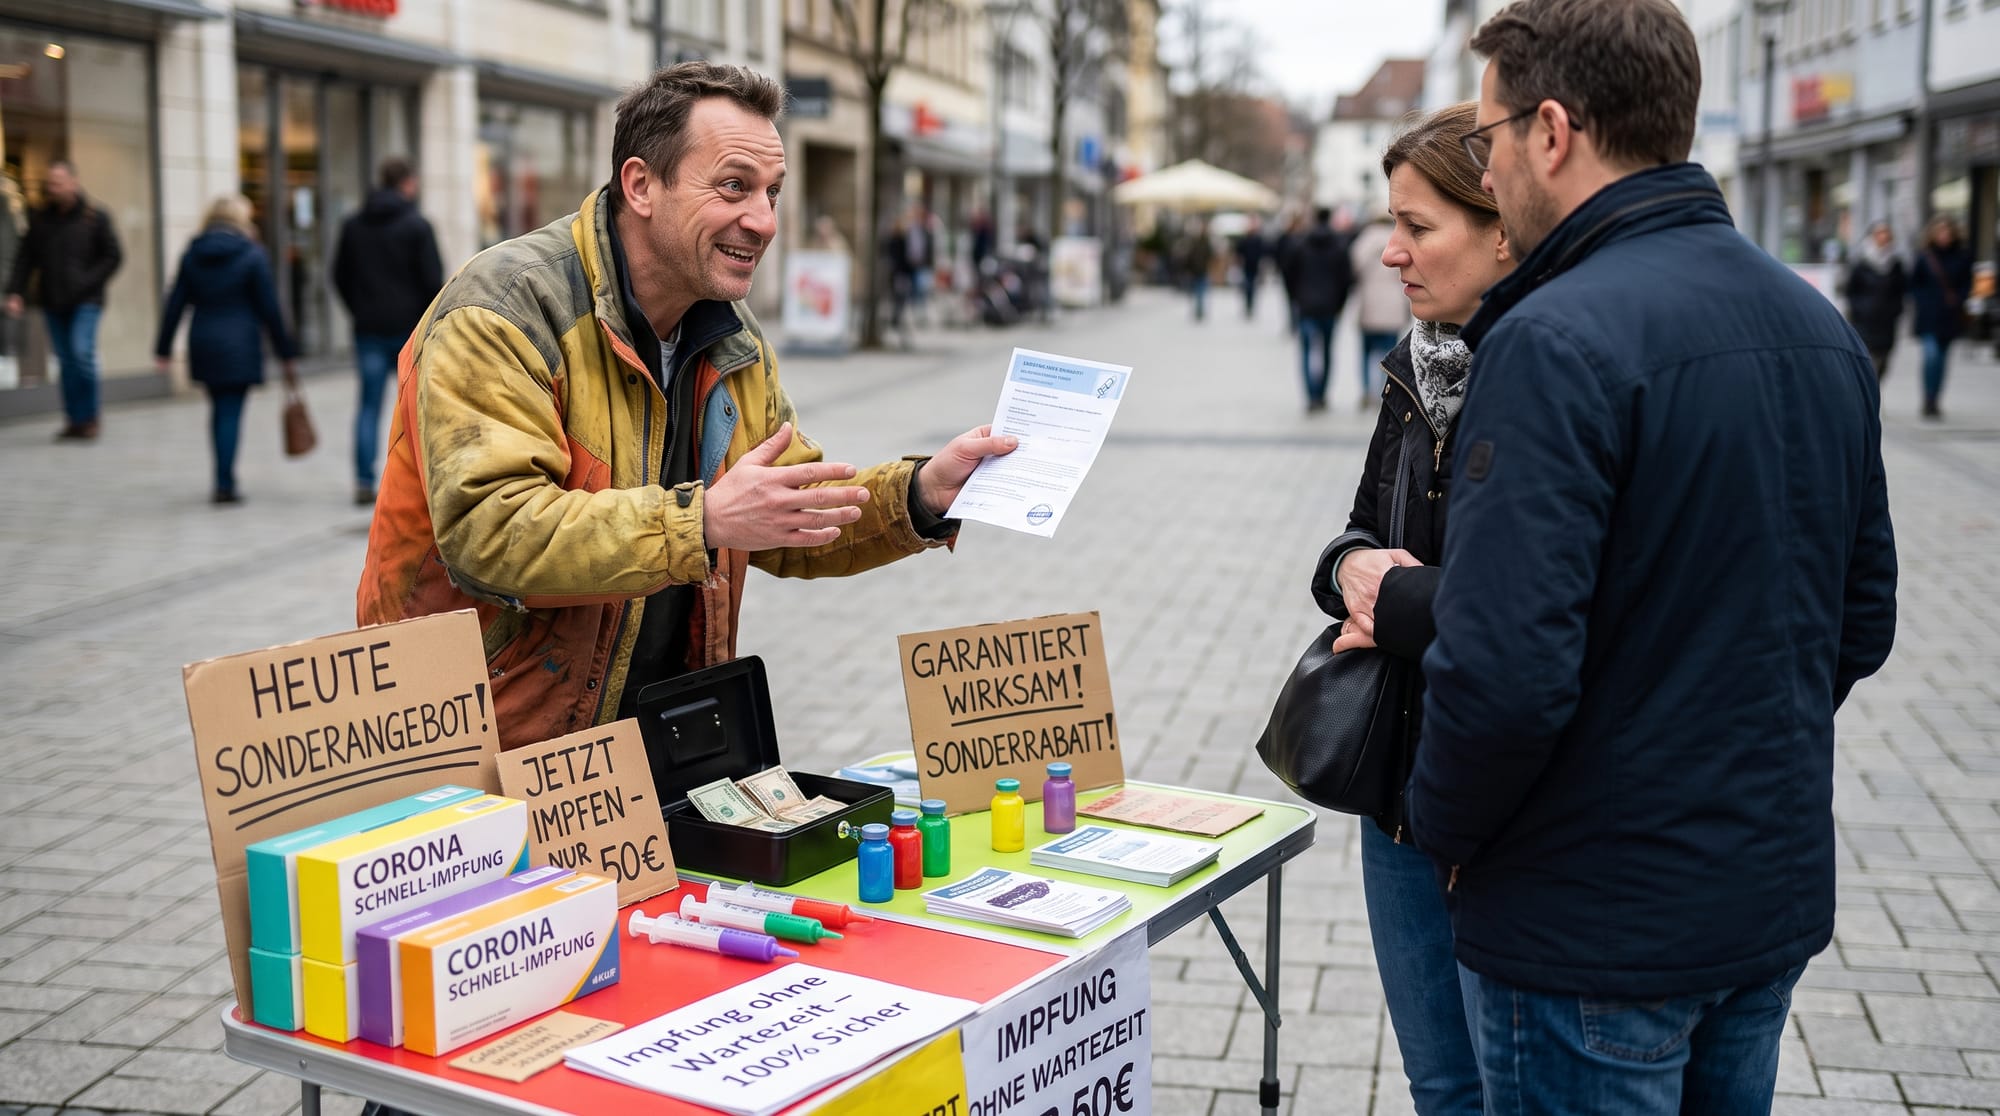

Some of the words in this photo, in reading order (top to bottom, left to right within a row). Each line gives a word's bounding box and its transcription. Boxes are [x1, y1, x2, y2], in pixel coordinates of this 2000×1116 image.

[249, 641, 397, 719] HEUTE
[911, 623, 1090, 679] GARANTIERT
[943, 663, 1084, 716] WIRKSAM!
[215, 683, 488, 797] SONDERANGEBOT!
[522, 736, 615, 797] JETZT
[925, 712, 1116, 779] SONDERRABATT!
[353, 833, 464, 890] CORONA
[354, 849, 504, 915] SCHNELL-IMPFUNG
[548, 842, 592, 869] NUR
[600, 834, 665, 884] 50€
[447, 916, 555, 976] CORONA
[448, 931, 595, 1002] SCHNELL-IMPFUNG
[607, 1009, 743, 1068] Impfung
[748, 973, 828, 1013] ohne
[671, 998, 832, 1074] Wartezeit
[721, 1043, 820, 1089] 100%
[815, 999, 912, 1048] Sicher
[997, 967, 1118, 1063] IMPFUNG
[969, 1073, 1025, 1116] OHNE
[1031, 1008, 1147, 1094] WARTEZEIT
[1071, 1061, 1134, 1116] 50€
